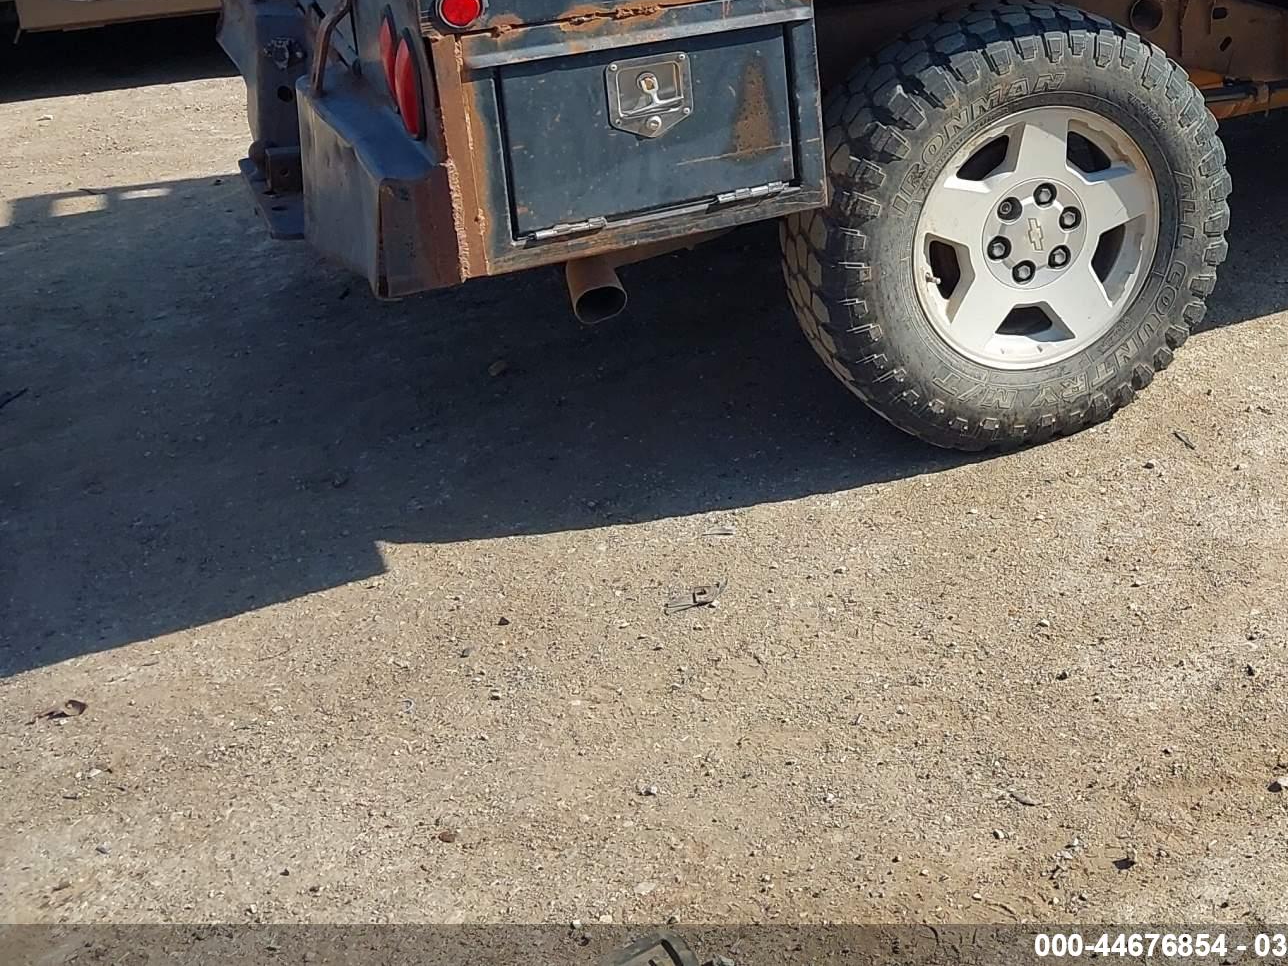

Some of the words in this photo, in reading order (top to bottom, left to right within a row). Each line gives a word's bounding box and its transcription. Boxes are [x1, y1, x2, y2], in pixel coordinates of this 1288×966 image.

[891, 72, 1067, 213] IRONMAN
[1173, 170, 1197, 249] ALL
[1030, 259, 1188, 410] COUNTRY
[931, 370, 1019, 411] M/T
